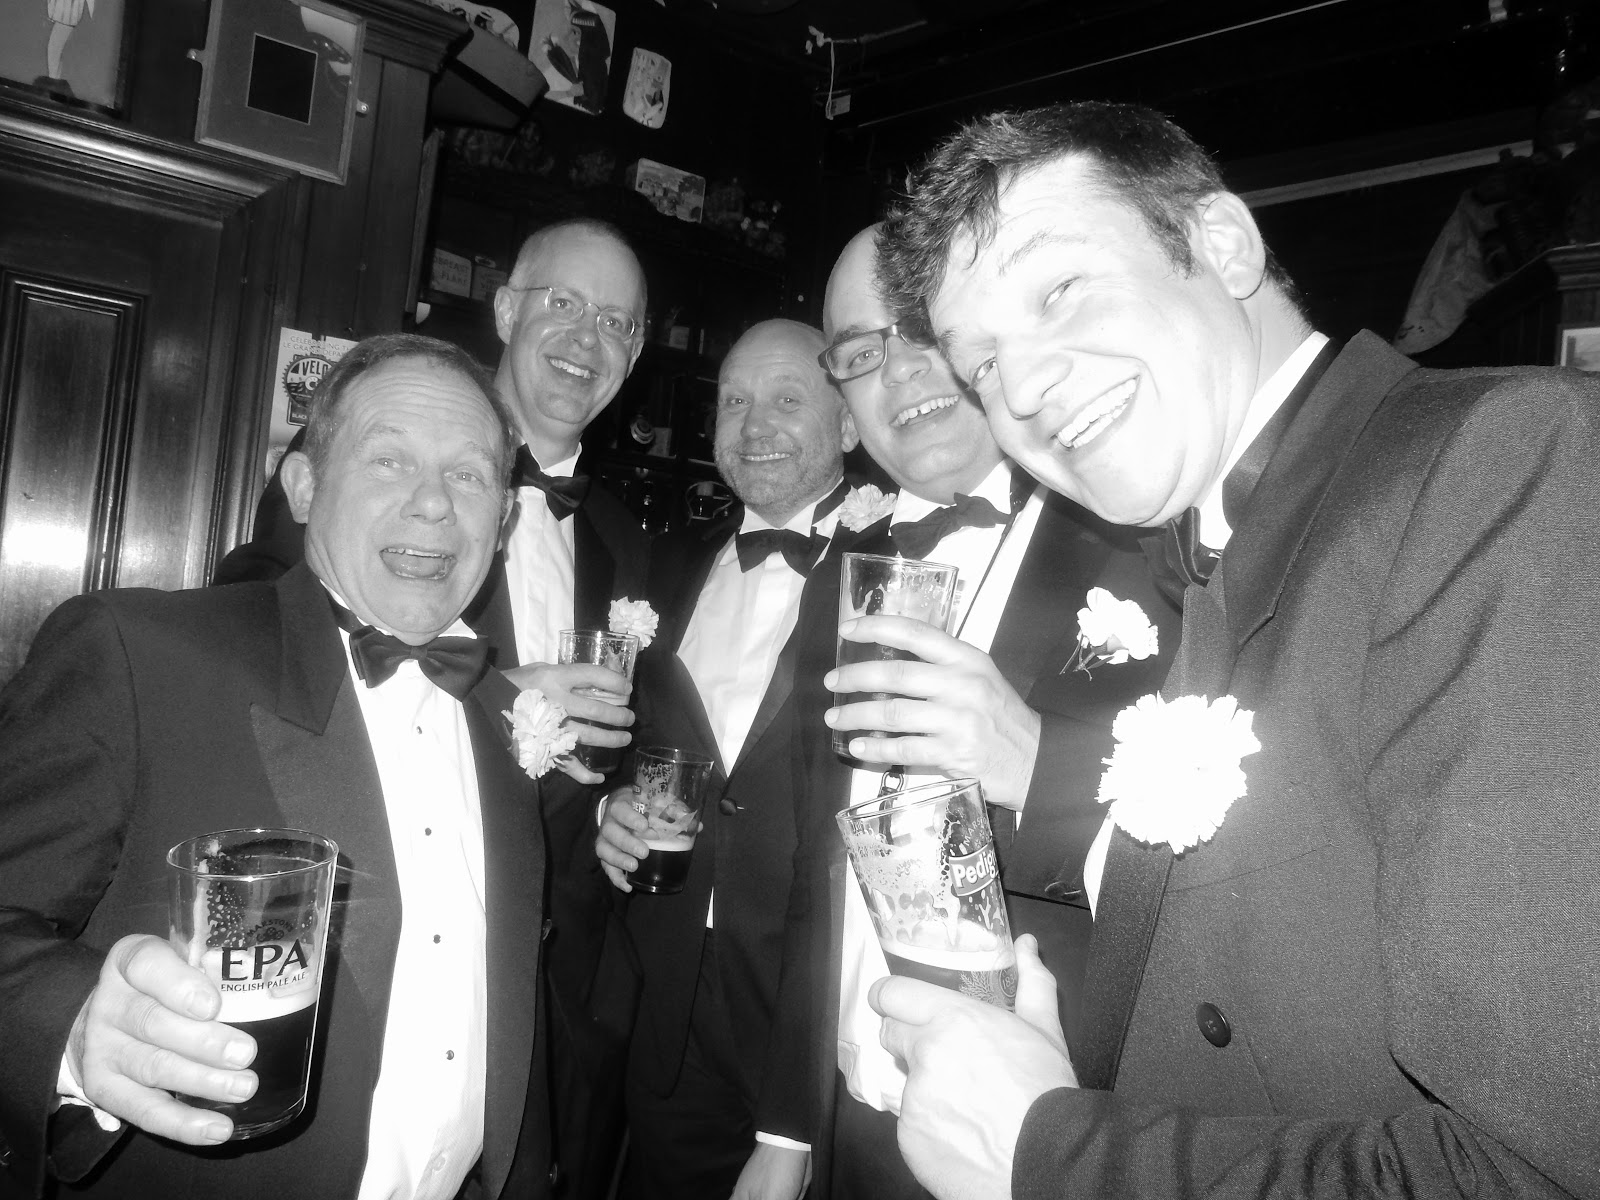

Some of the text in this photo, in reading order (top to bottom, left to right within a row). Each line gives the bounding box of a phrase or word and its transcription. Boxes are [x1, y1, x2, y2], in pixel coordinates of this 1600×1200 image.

[221, 939, 308, 982] EPA
[221, 971, 306, 992] ENGLISH PALE ALE
